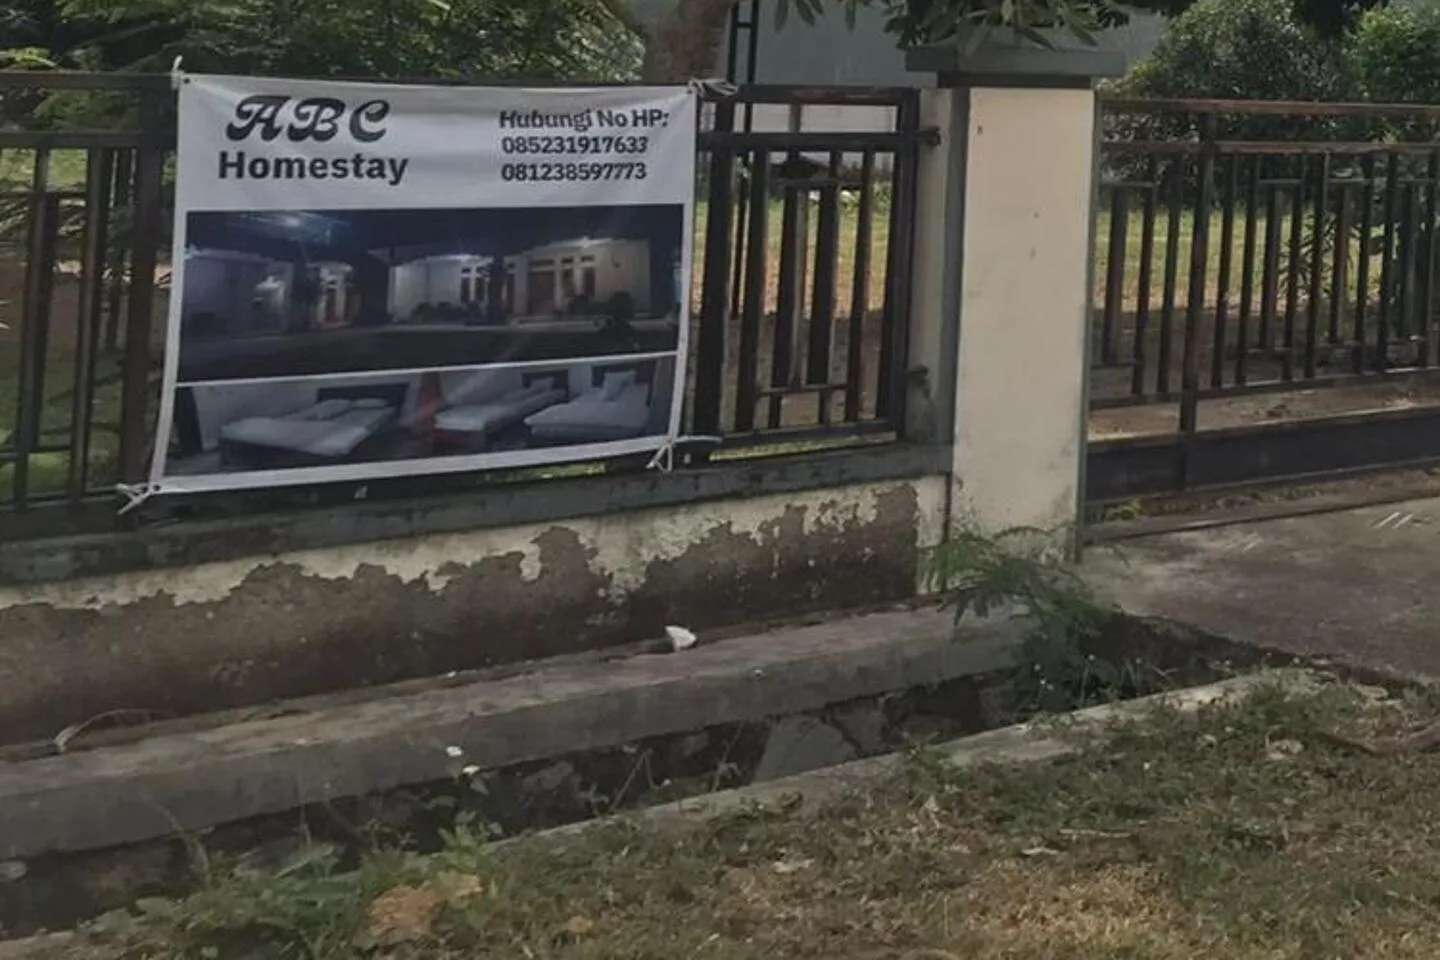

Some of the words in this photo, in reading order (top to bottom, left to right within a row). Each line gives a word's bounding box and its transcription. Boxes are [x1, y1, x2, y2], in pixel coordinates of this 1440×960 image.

[226, 95, 390, 142] ABC
[499, 109, 593, 132] Hubungi
[597, 110, 628, 128] No
[631, 109, 670, 128] HP:
[502, 136, 649, 154] 085231917633
[218, 151, 409, 186] Homestay
[501, 162, 647, 181] 081238597773
